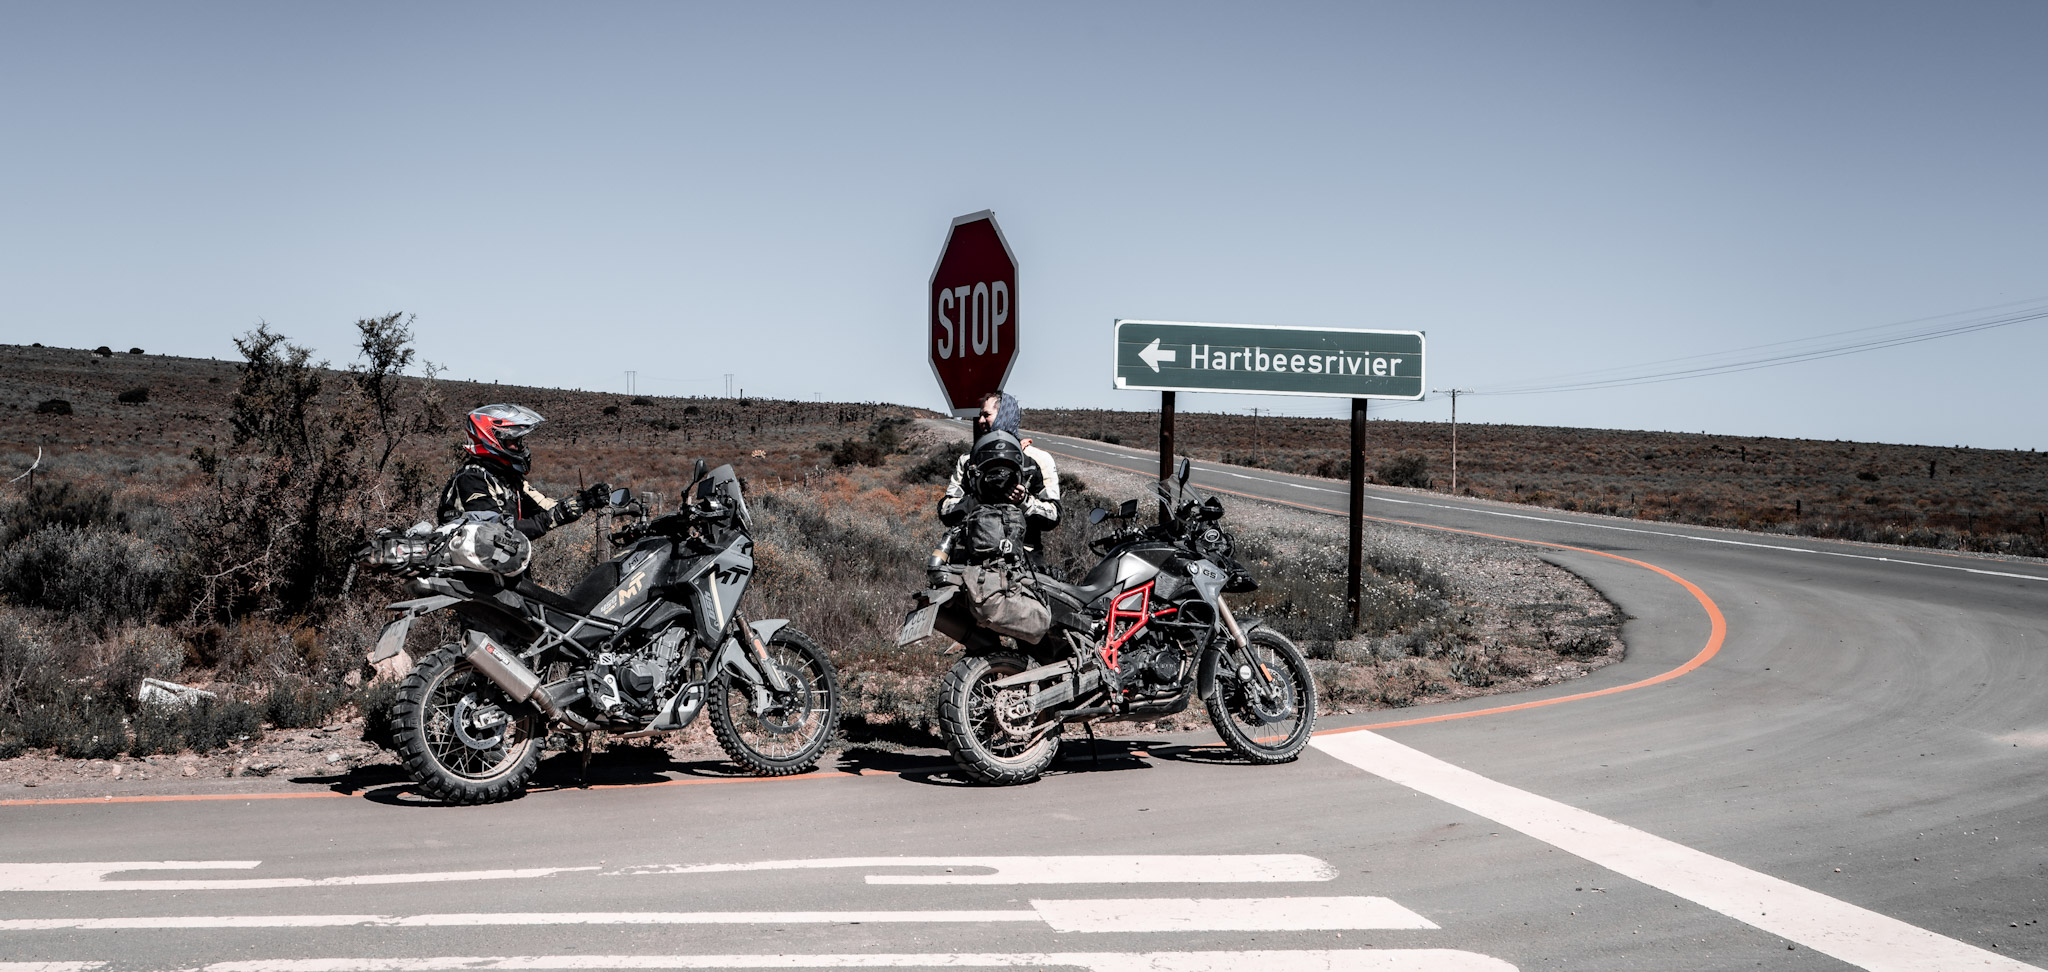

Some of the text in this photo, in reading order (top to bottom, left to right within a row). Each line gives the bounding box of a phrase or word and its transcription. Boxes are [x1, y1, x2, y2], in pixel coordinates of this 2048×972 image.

[938, 280, 1009, 359] STOP
[1190, 343, 1403, 377] Hartbeesrivier
[700, 563, 751, 586] MT
[1203, 569, 1217, 579] GS
[618, 570, 646, 607] MT
[600, 594, 617, 613] 450
